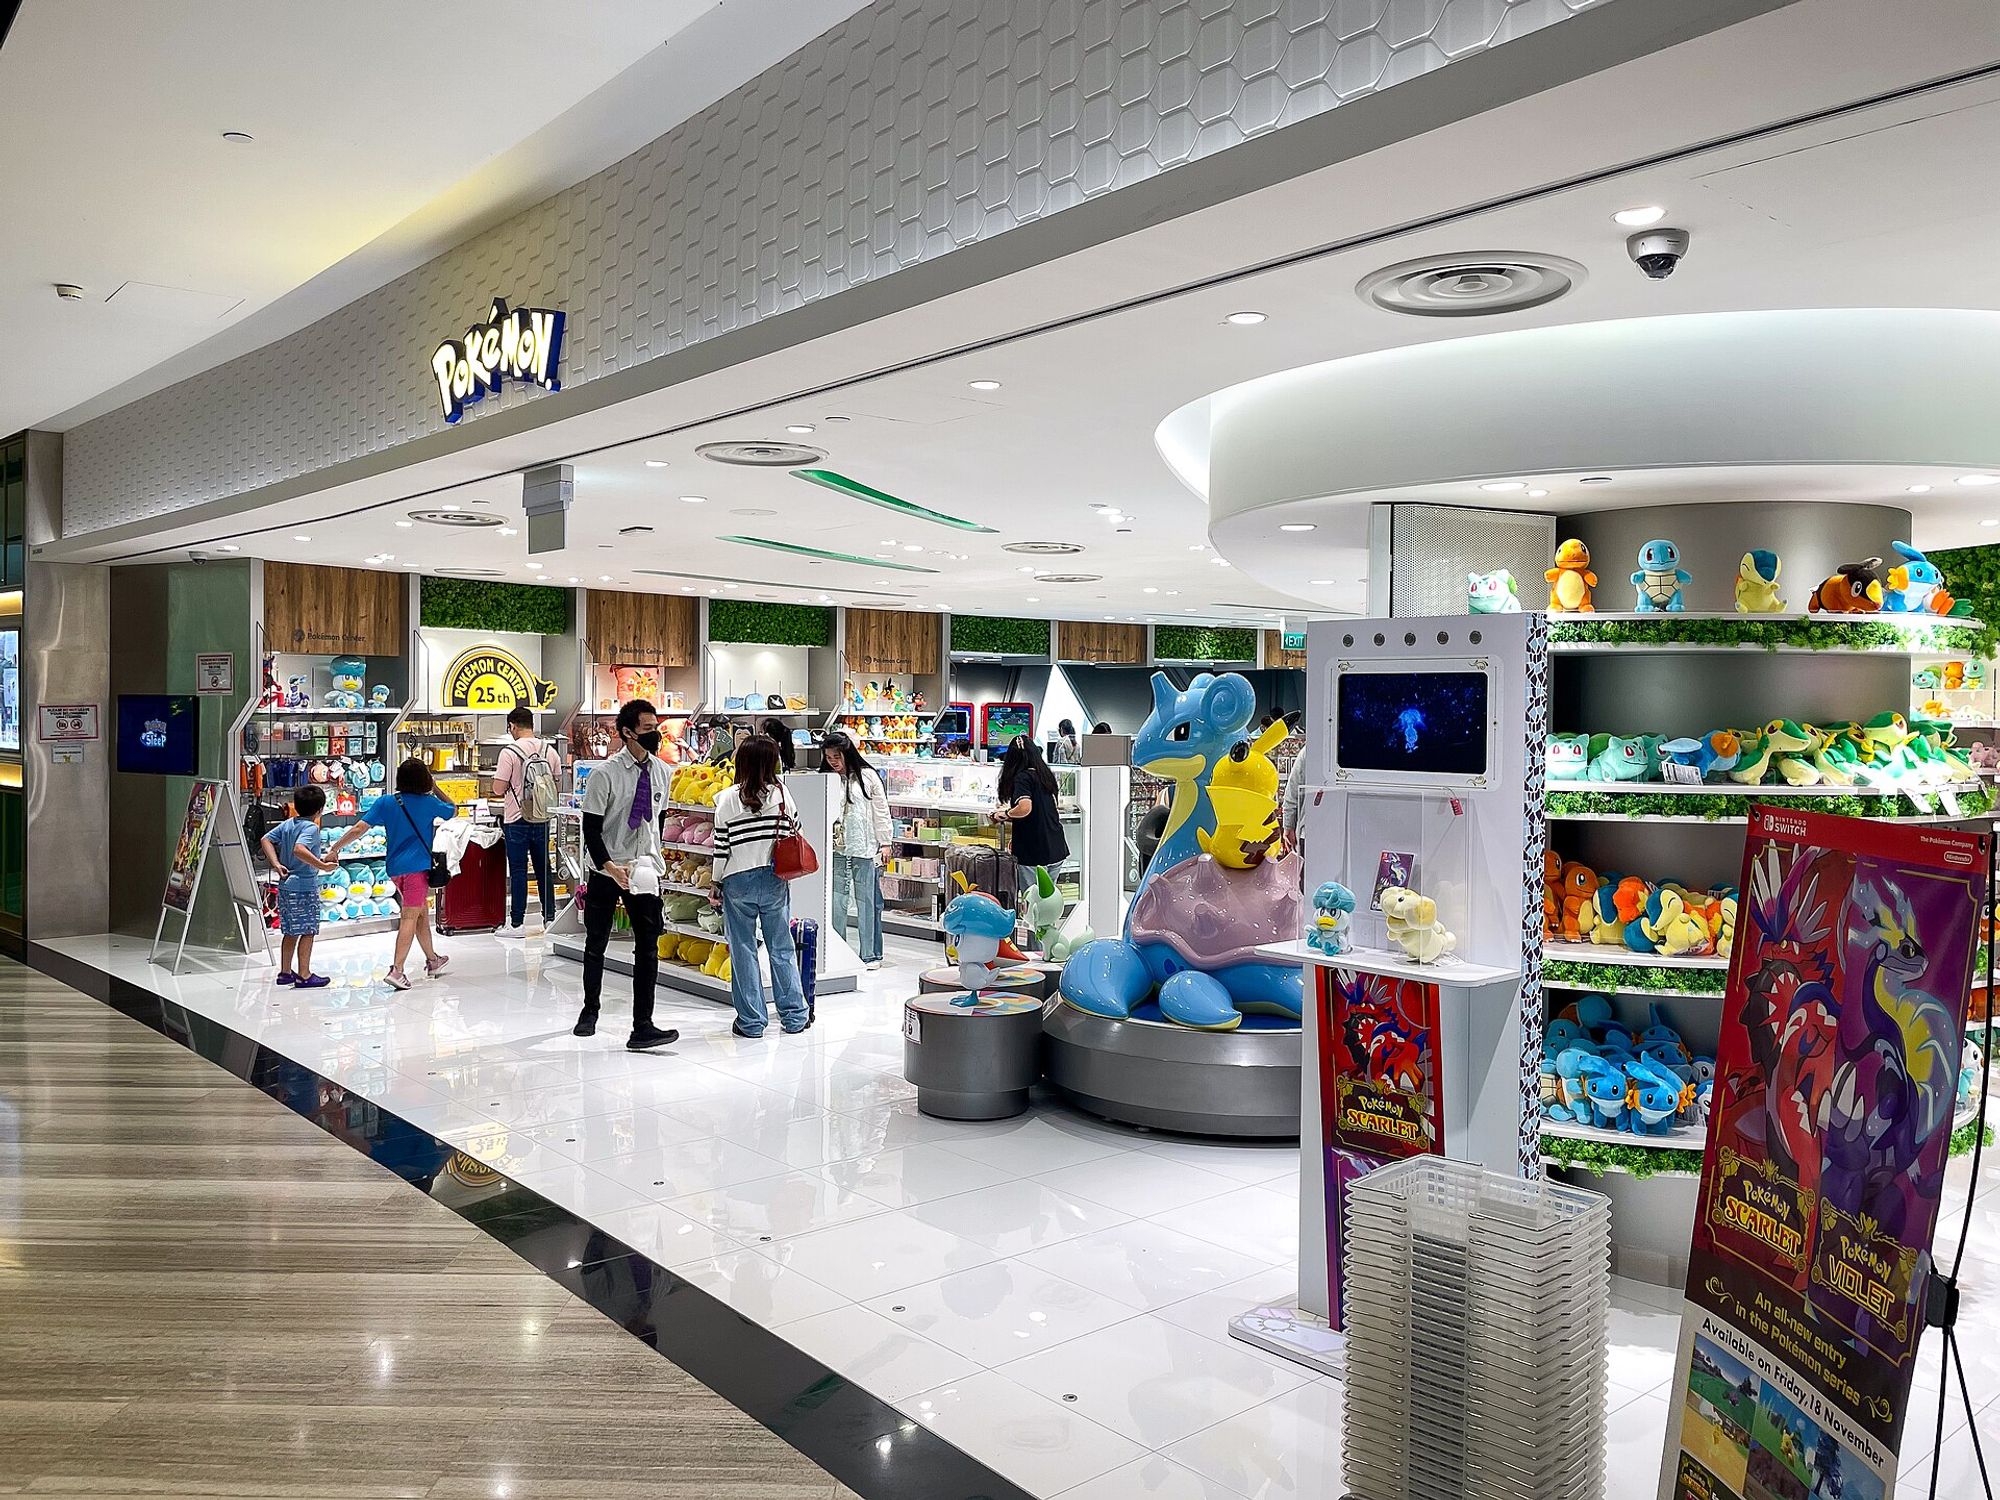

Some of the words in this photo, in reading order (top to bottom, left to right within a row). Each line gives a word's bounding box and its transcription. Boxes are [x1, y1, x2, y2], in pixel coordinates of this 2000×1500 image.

[1288, 635, 1304, 647] EXIT
[454, 658, 495, 700] POKÉMON
[496, 661, 528, 701] CENTER
[475, 686, 510, 703] 25th
[1774, 822, 1807, 837] SWITCH
[1775, 816, 1807, 826] NINTENDO
[1347, 1108, 1419, 1141] SCARLET
[1724, 1195, 1801, 1259] SCARLET
[1828, 1254, 1896, 1319] VIOLET
[1755, 1291, 1771, 1313] An
[1774, 1304, 1813, 1342] all-new
[1813, 1335, 1847, 1370] entry
[1735, 1301, 1747, 1320] in
[1749, 1311, 1769, 1335] the
[1770, 1326, 1822, 1376] Pokémon
[1822, 1367, 1861, 1407] series
[1702, 1316, 1755, 1362] Available
[1757, 1356, 1772, 1375] on
[1823, 1408, 1884, 1469] November
